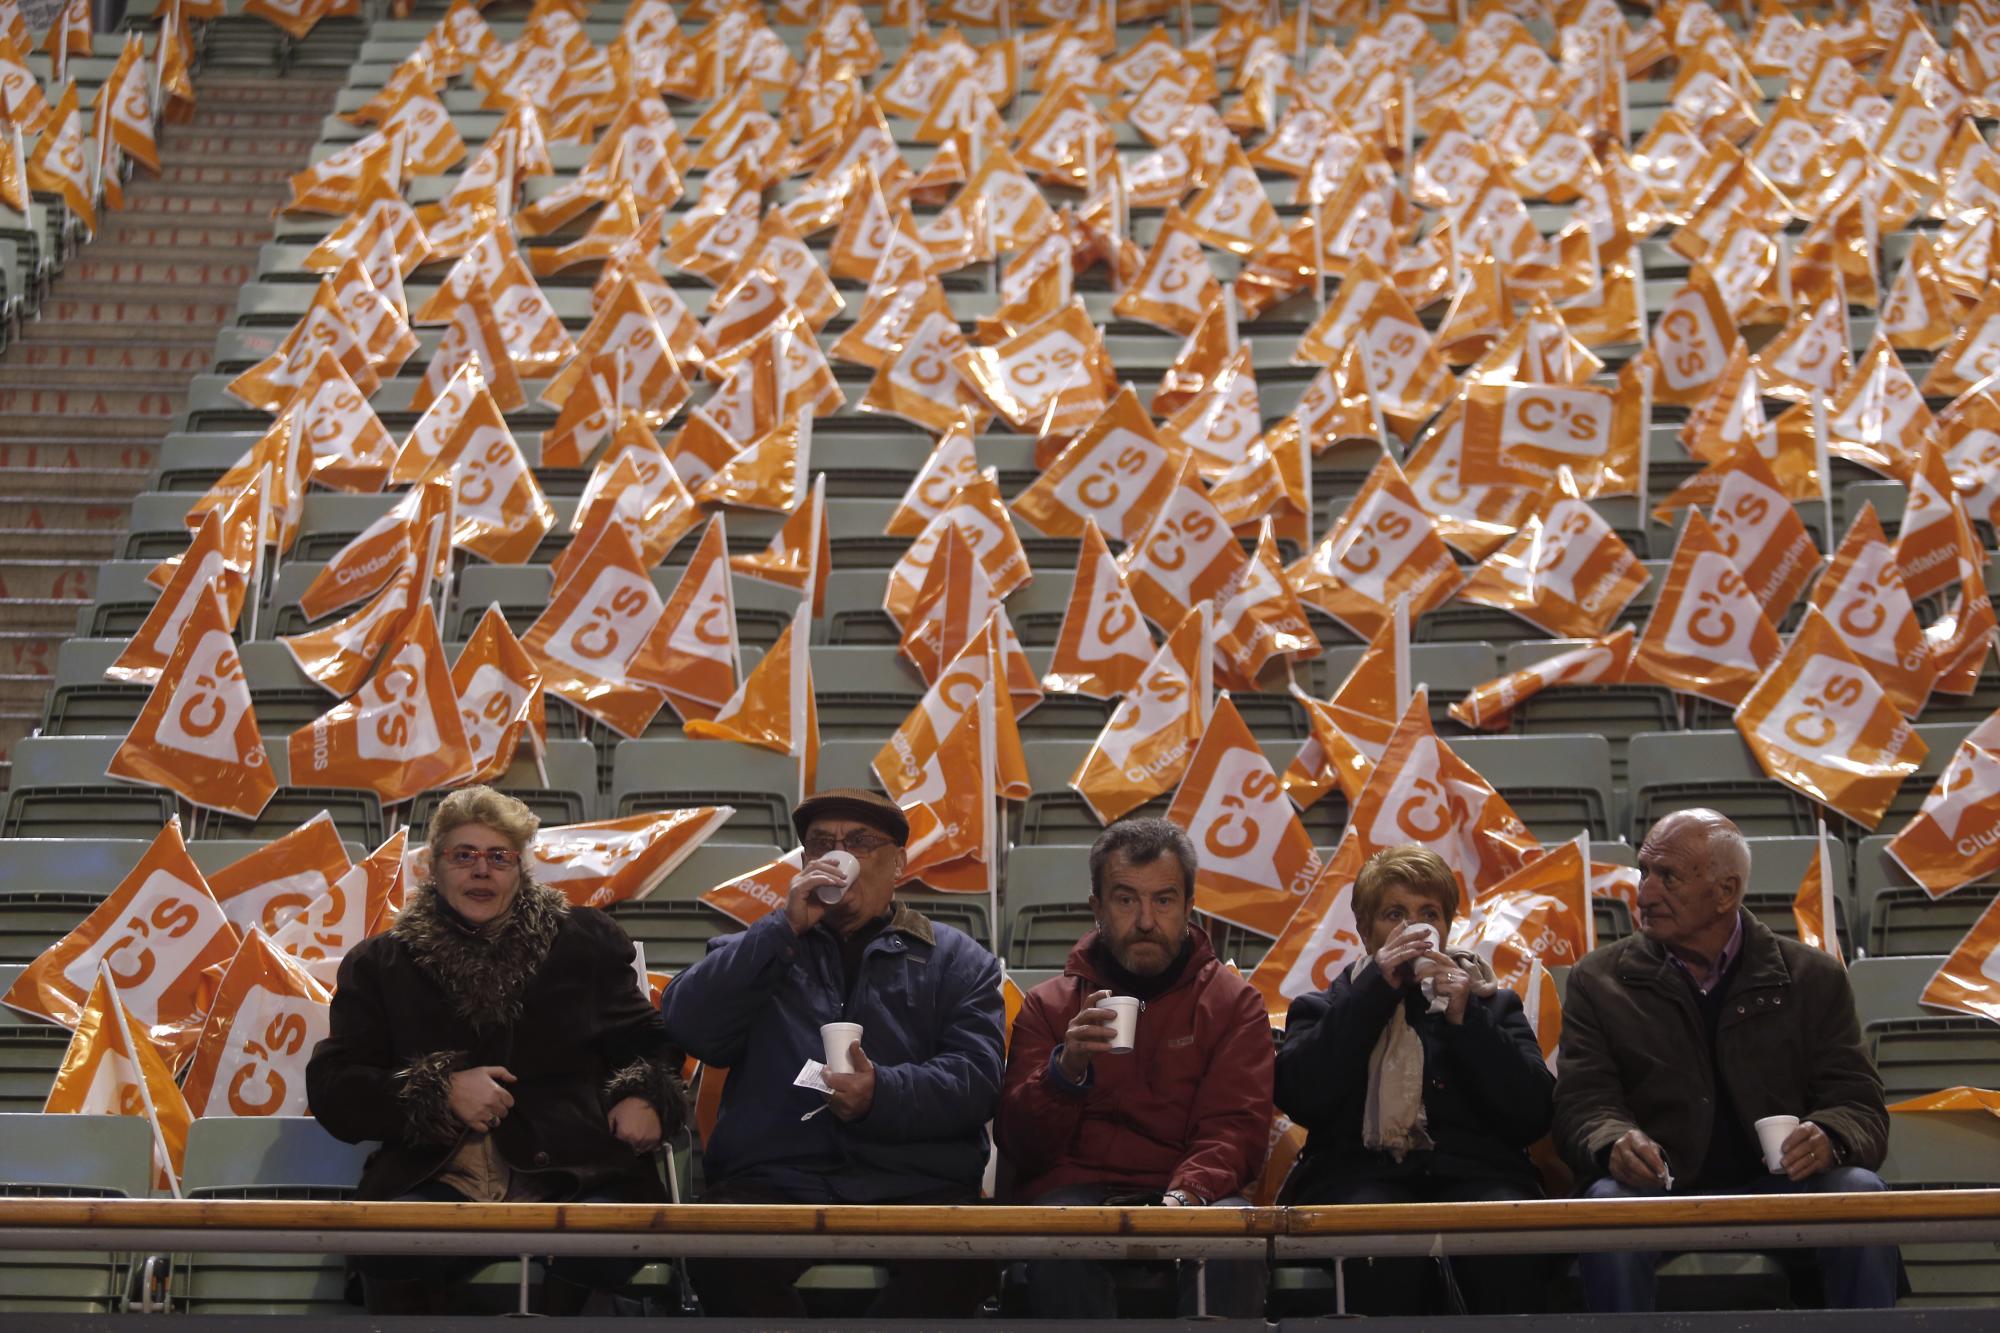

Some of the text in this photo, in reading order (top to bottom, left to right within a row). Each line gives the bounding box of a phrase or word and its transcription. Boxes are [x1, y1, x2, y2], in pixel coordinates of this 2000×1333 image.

[1011, 348, 1077, 387] C's
[1663, 308, 1707, 380] C's
[310, 391, 364, 443] C's
[1517, 395, 1599, 441] C's
[457, 439, 512, 507] C's
[1078, 447, 1147, 508] C's
[1146, 506, 1217, 571] C's
[571, 586, 647, 659] C's
[1688, 567, 1750, 646] C's
[1839, 558, 1903, 638] C's
[375, 664, 418, 747] C's
[1785, 673, 1864, 747] C's
[1205, 768, 1282, 860] C's
[103, 896, 198, 989] C's
[229, 1012, 307, 1117] C's
